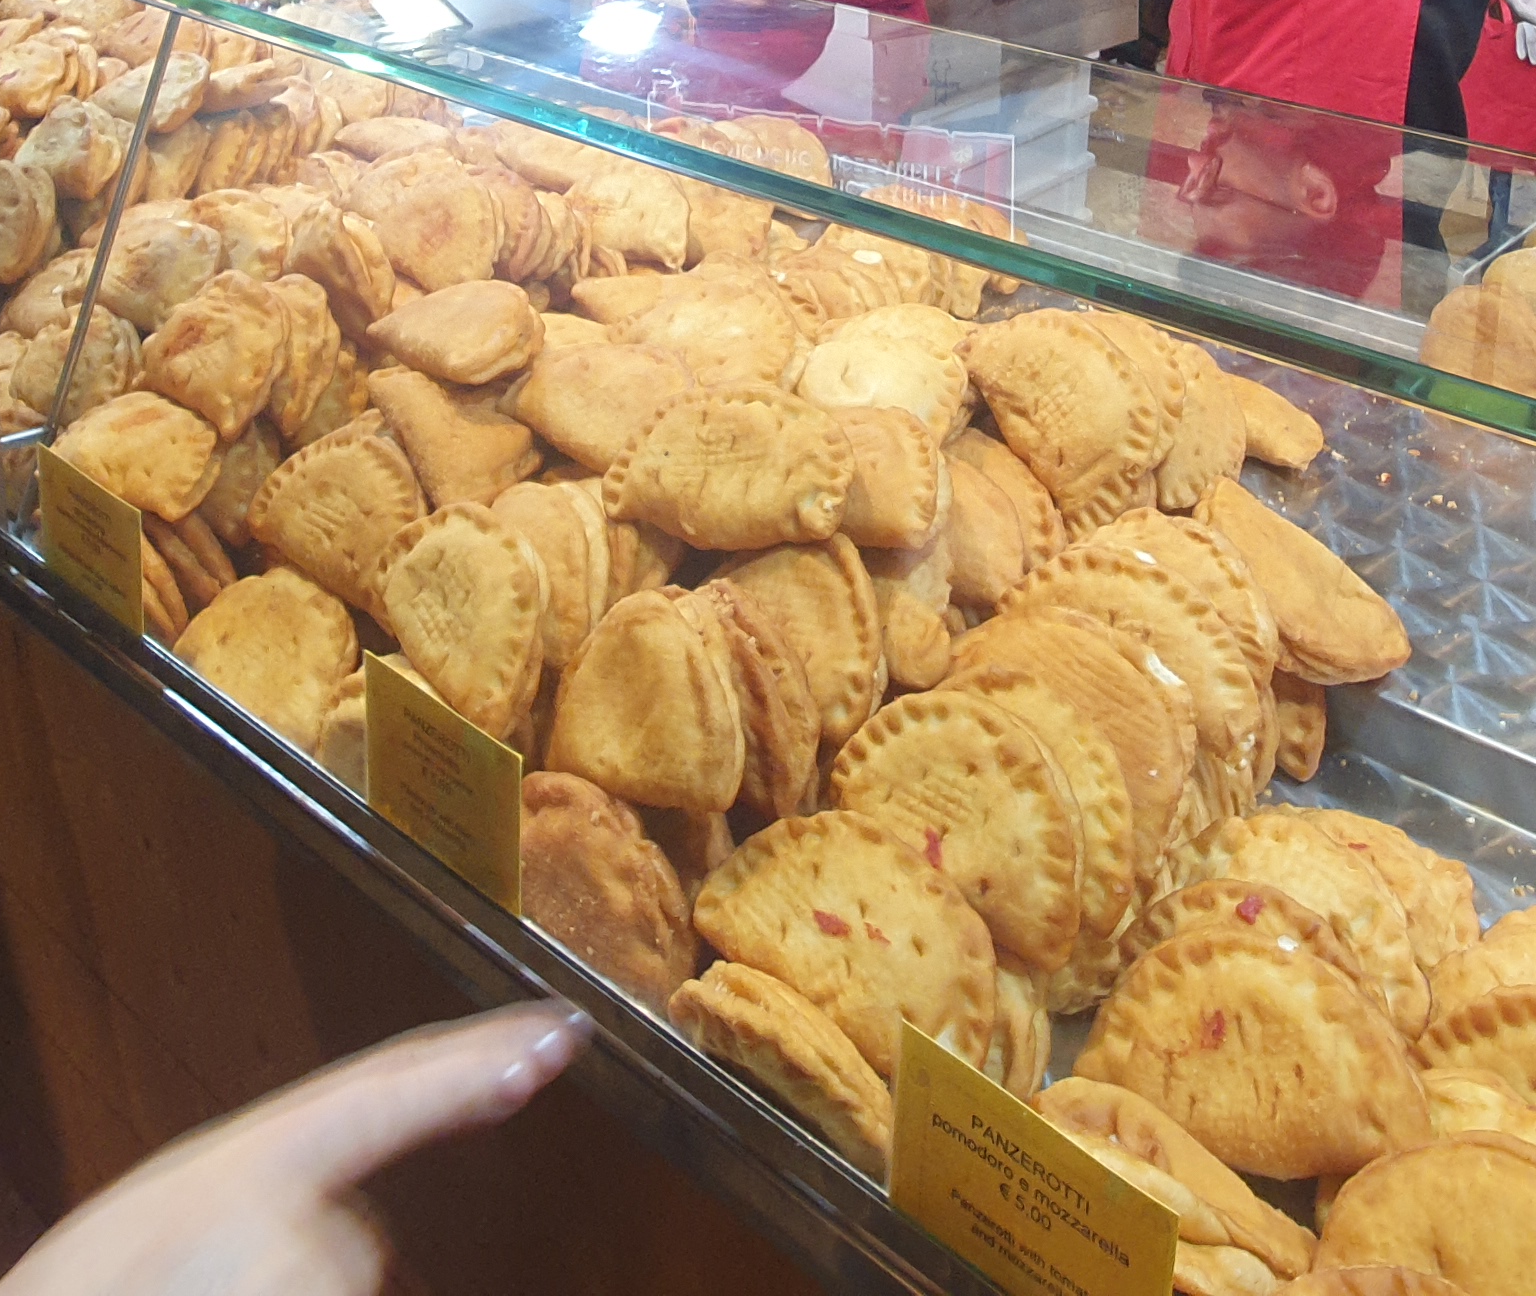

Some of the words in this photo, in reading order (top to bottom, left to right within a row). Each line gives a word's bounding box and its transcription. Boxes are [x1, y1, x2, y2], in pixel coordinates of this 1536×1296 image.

[932, 1113, 1013, 1180] pomodoro
[1019, 1178, 1029, 1191] e
[1034, 1190, 1130, 1268] mozzarella
[972, 1115, 1090, 1215] PANZEROTTI
[971, 1222, 995, 1248] and
[1019, 1245, 1046, 1269] with
